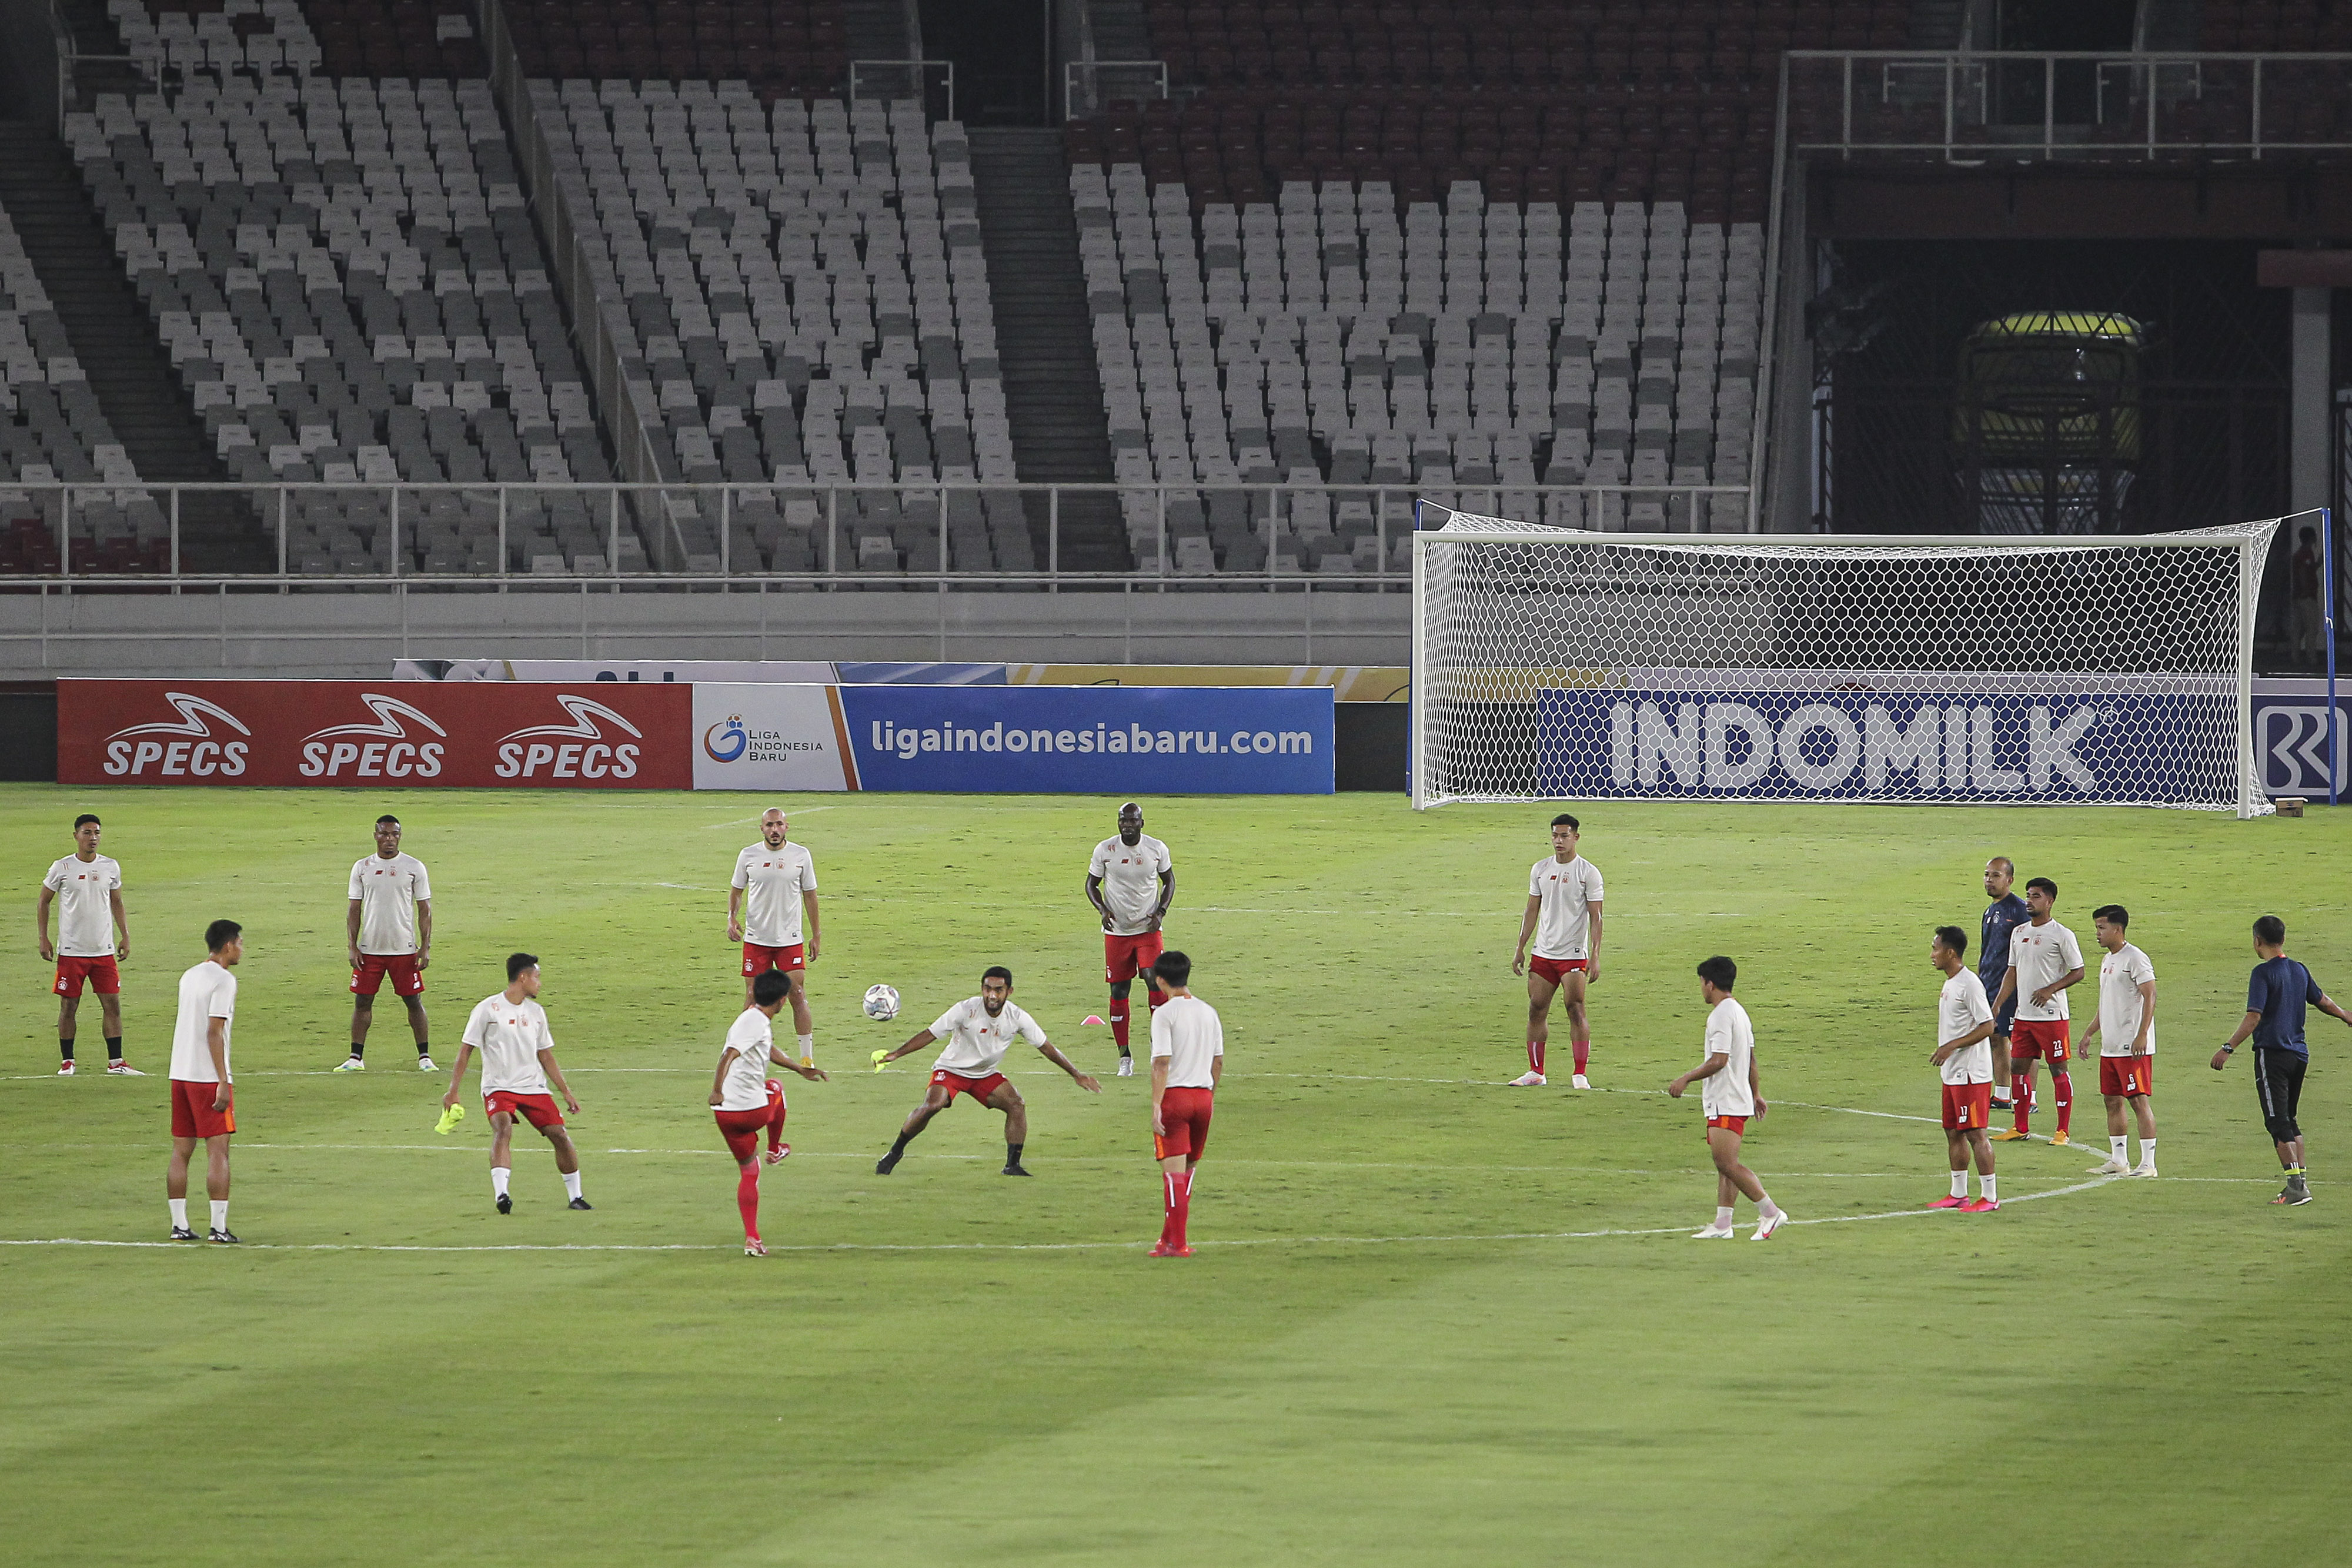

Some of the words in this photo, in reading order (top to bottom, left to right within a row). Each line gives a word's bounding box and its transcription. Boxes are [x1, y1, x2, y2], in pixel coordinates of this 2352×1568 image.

[749, 730, 780, 740] LIGA
[873, 720, 1312, 760] ligaindonesiabaru.com
[749, 741, 823, 751] INDONESIA
[103, 741, 249, 776] SPECS
[299, 742, 445, 777] SPECS
[495, 743, 640, 778] SPECS
[749, 752, 787, 761] BARU
[2053, 1039, 2063, 1050] 22
[2129, 1074, 2134, 1083] 6
[1960, 1105, 1967, 1115] 17
